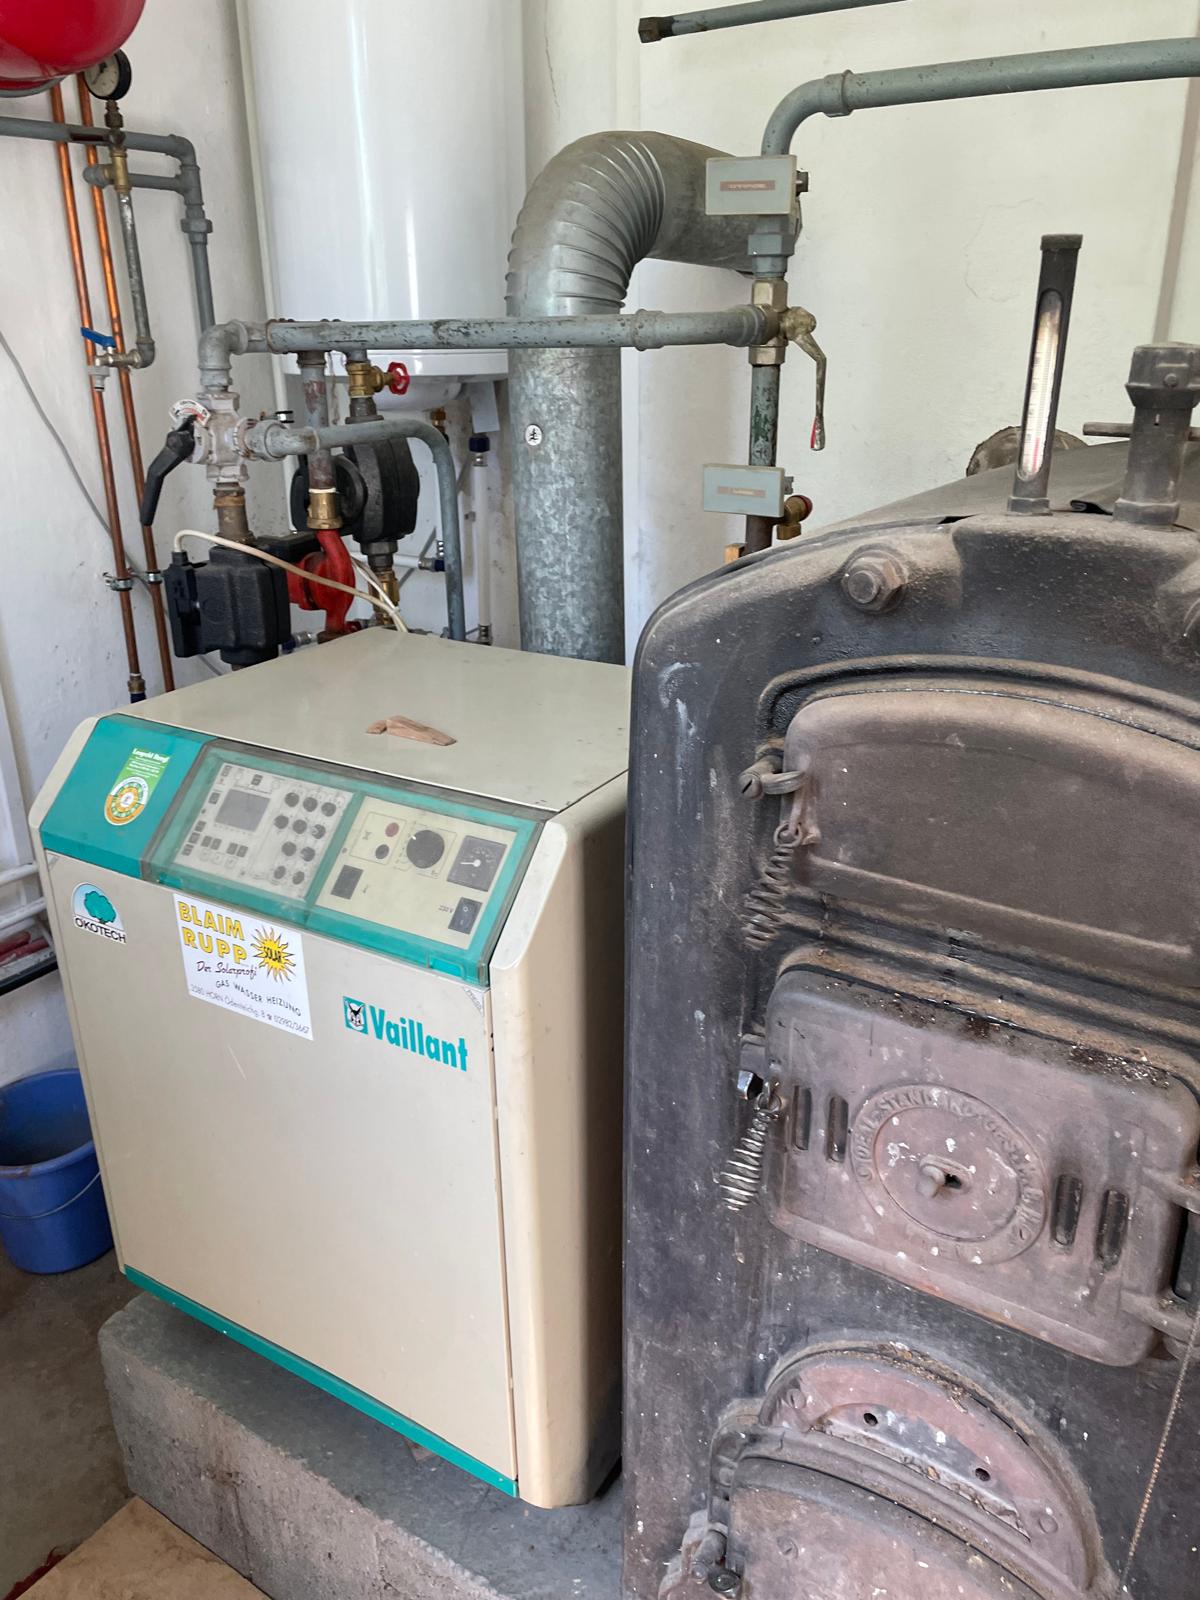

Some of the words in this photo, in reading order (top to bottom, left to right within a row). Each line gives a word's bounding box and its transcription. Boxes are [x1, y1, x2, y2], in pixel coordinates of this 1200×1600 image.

[178, 901, 245, 941] BLAIM
[181, 926, 248, 964] RUPP
[263, 945, 283, 963] SOLAR
[196, 960, 212, 973] Der
[215, 961, 258, 980] Solarprofi
[216, 979, 230, 988] GAS
[233, 982, 263, 1003] WASSER
[266, 995, 302, 1017] HEIZUNG
[368, 1004, 468, 1072] Vaillant
